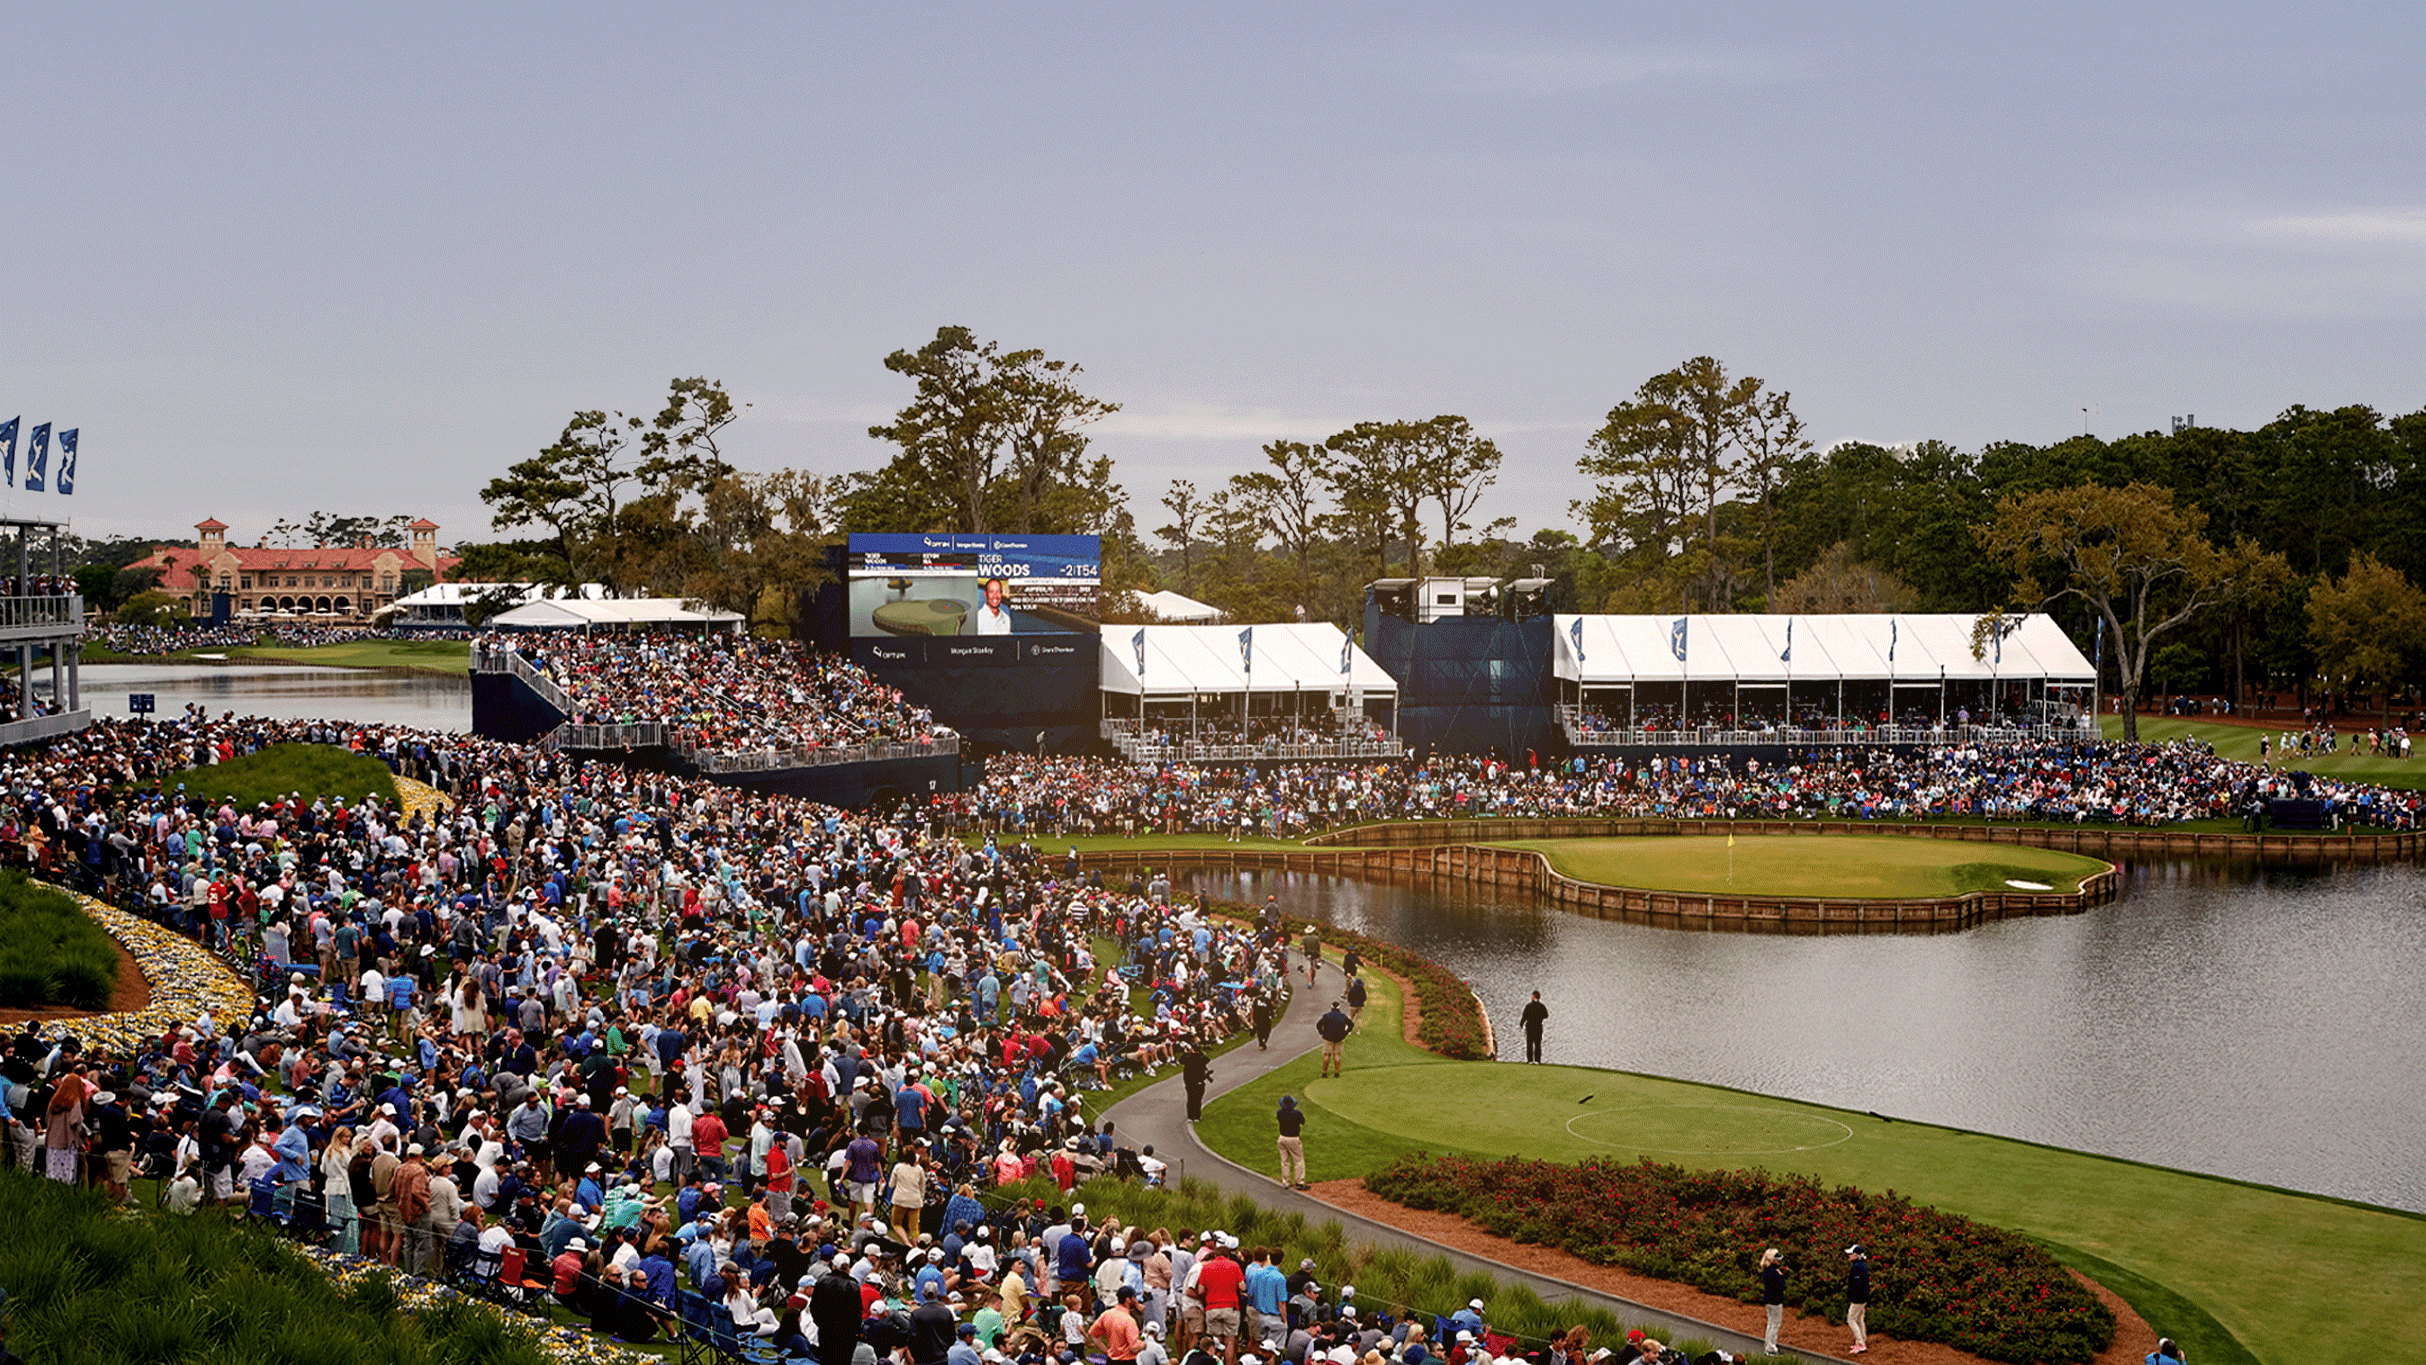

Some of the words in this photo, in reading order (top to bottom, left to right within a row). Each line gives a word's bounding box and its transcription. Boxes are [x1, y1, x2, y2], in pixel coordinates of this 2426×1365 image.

[978, 554, 1003, 563] TIGER
[978, 563, 1031, 577] WOODS
[929, 780, 937, 790] 17
